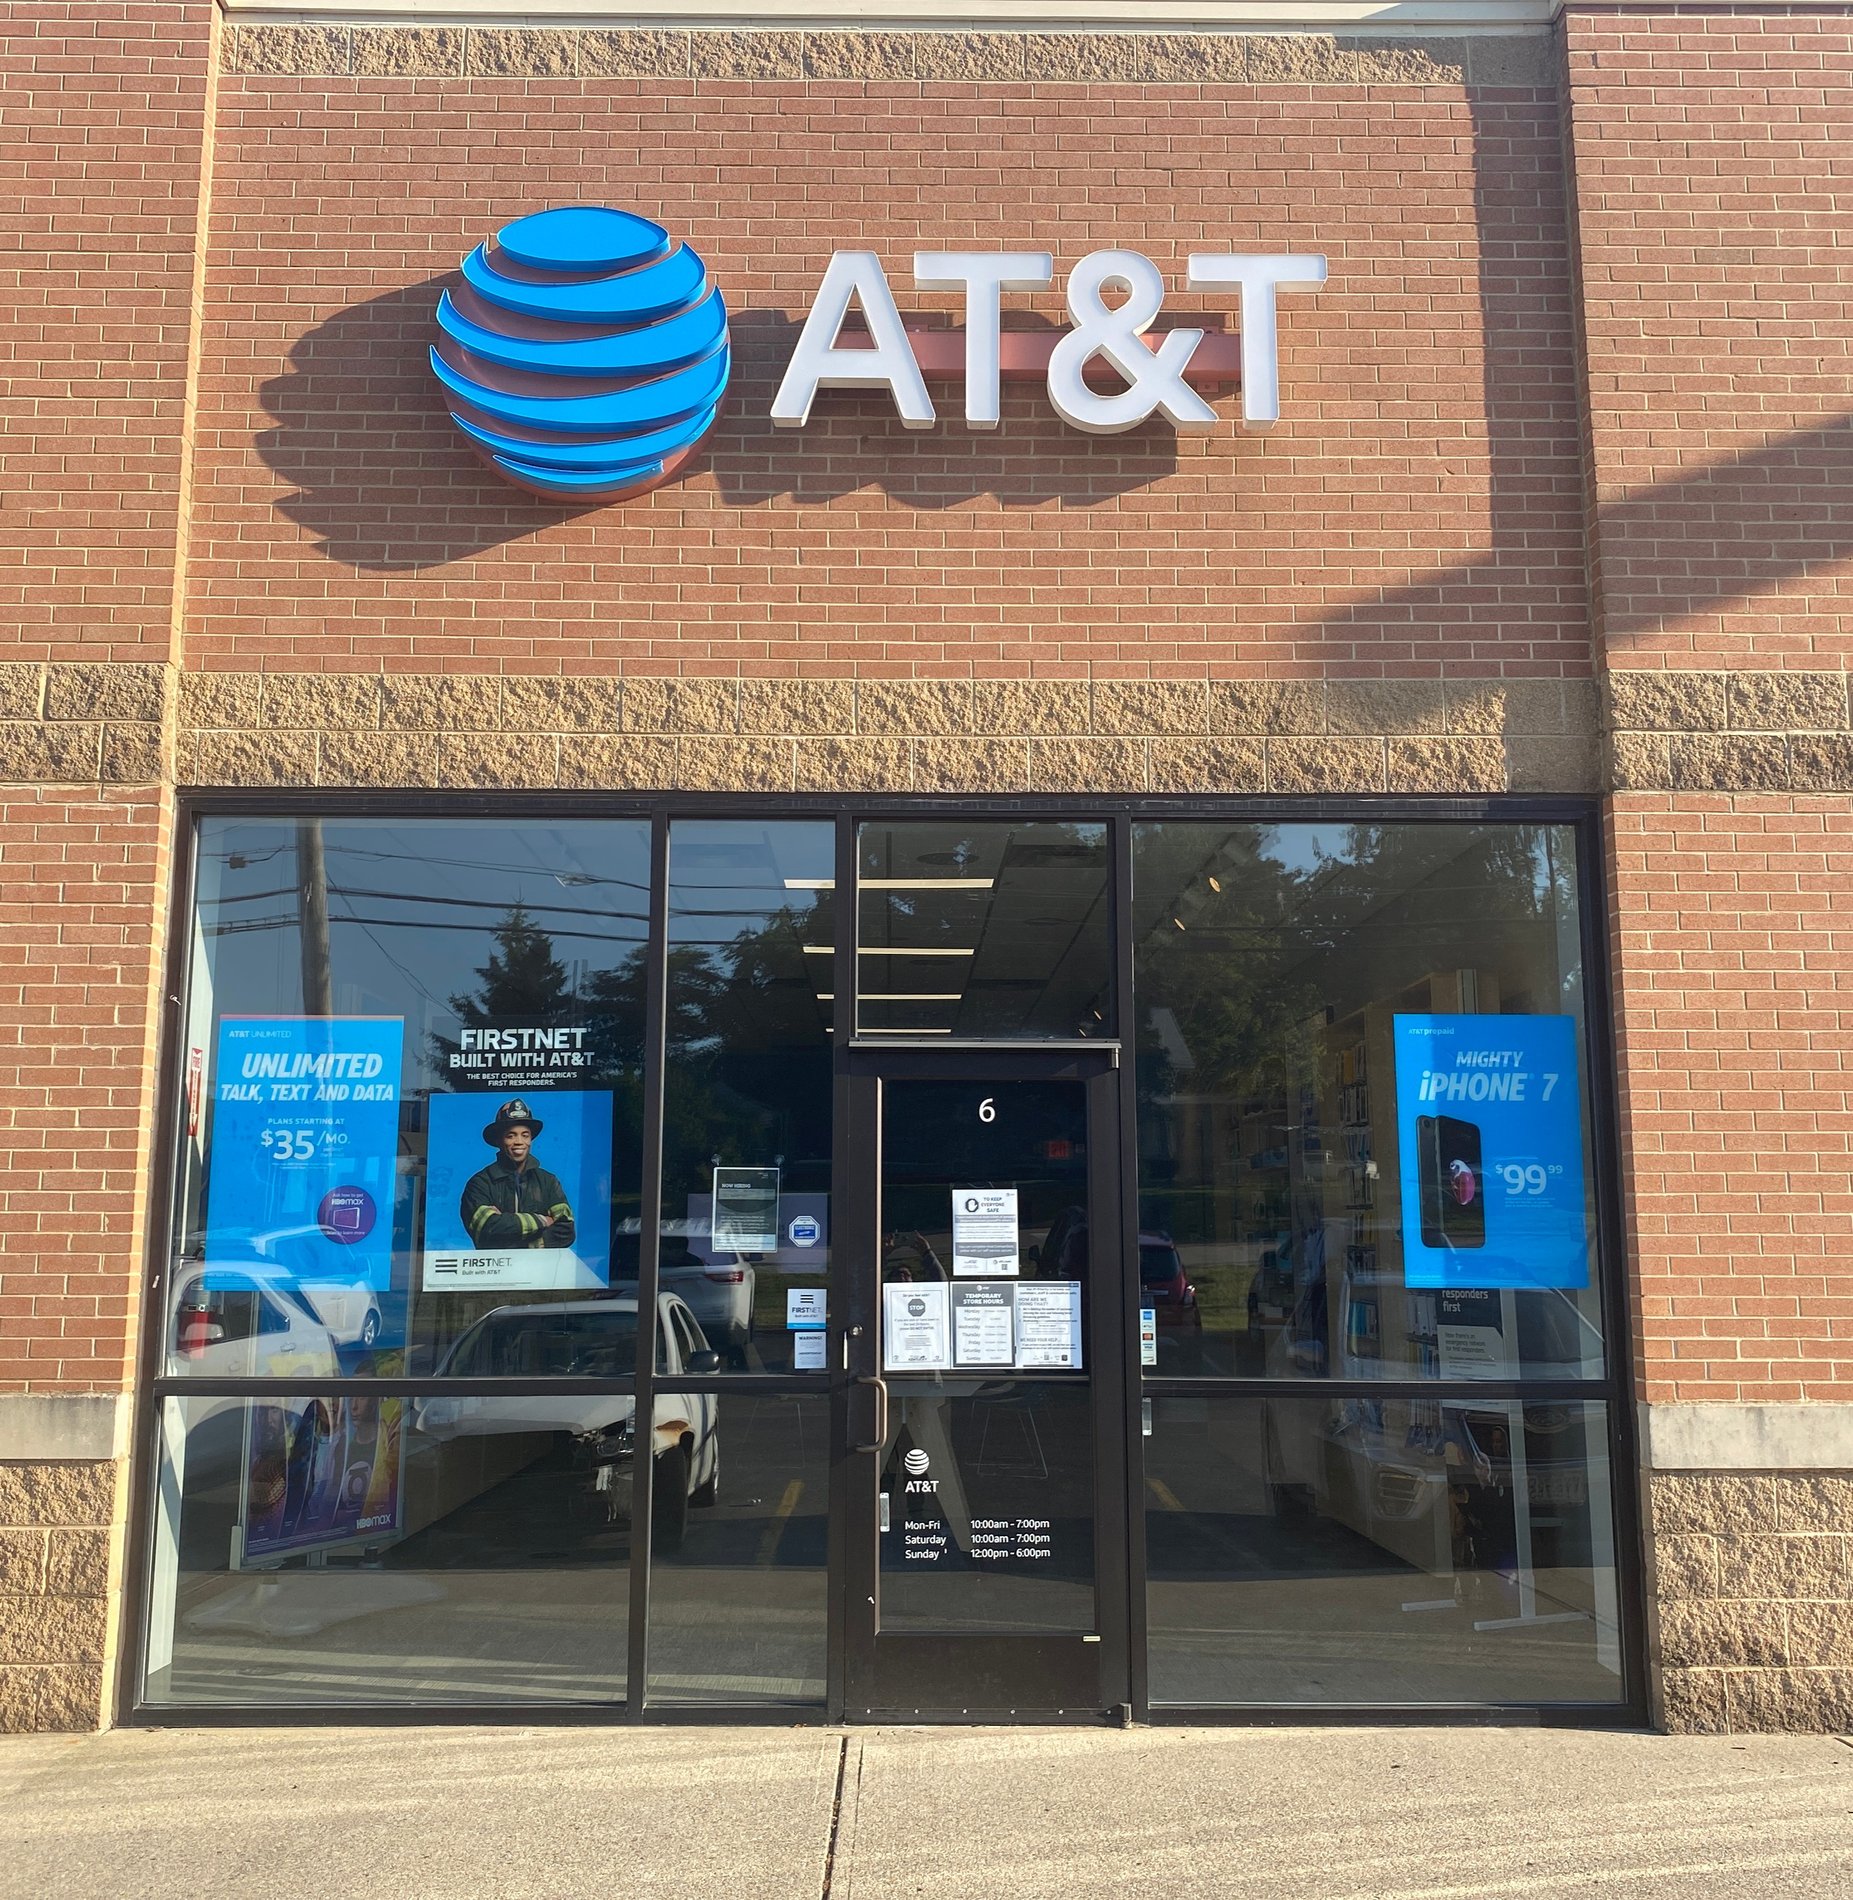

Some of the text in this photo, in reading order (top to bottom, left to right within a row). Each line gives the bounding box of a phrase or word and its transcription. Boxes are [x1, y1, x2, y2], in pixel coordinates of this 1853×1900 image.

[770, 249, 1328, 433] AT&T
[228, 1030, 292, 1038] AT&T UNLIMITED
[460, 1028, 588, 1050] FIRSTNET
[241, 1053, 383, 1078] UNLIMITED
[449, 1051, 595, 1068] BUILT WITH AT&T
[1455, 1051, 1524, 1067] MIGHTY
[221, 1083, 394, 1104] TALK, TEXT AND DATA
[1418, 1070, 1559, 1101] iPHONE 7
[979, 1098, 996, 1122] 6
[1442, 1288, 1489, 1300] responders
[1442, 1301, 1461, 1312] first
[905, 1481, 939, 1493] AT&T
[905, 1520, 941, 1530] Mon-Fri
[970, 1520, 1009, 1529] 10:00am
[1016, 1519, 1050, 1530] 7:00pm
[905, 1535, 947, 1546] Saturday
[970, 1534, 1009, 1544] 10:00am
[1016, 1534, 1050, 1545] 7:00pm
[905, 1549, 940, 1560] Sunday
[970, 1549, 1009, 1560] 12:00pm
[1016, 1548, 1051, 1559] 6:00pm
